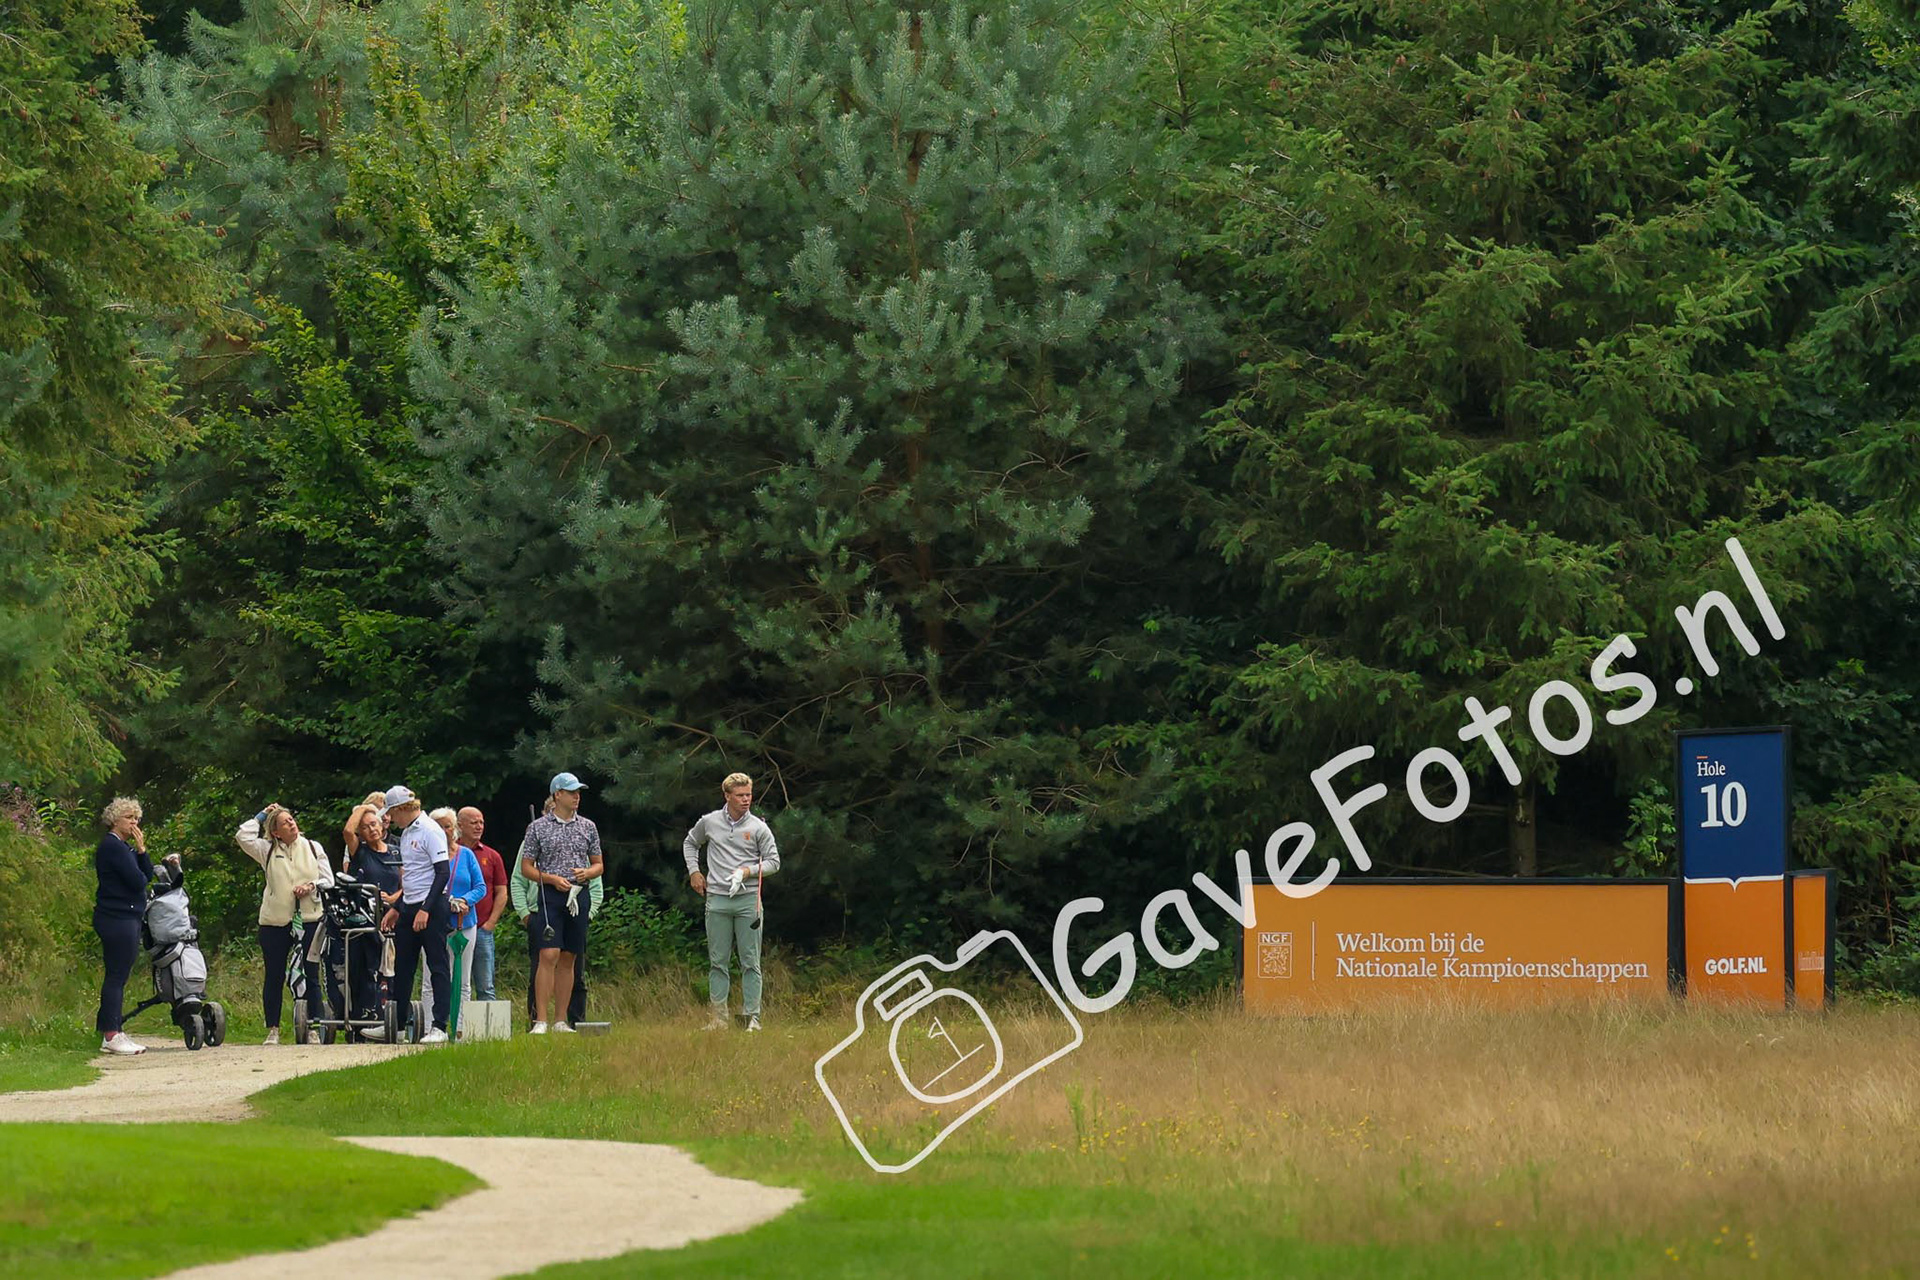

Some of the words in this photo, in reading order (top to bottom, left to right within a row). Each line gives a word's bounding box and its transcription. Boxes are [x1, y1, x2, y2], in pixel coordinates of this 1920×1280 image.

[1696, 760, 1726, 777] Hole
[1701, 781, 1747, 828] 10
[1260, 934, 1288, 943] NGF
[1336, 932, 1426, 954] Welkom
[1429, 932, 1456, 958] bij
[1460, 932, 1485, 954] de
[1336, 957, 1437, 978] Nationale
[1442, 957, 1649, 983] Kampioenschappen
[1705, 956, 1768, 976] GOLF.NL
